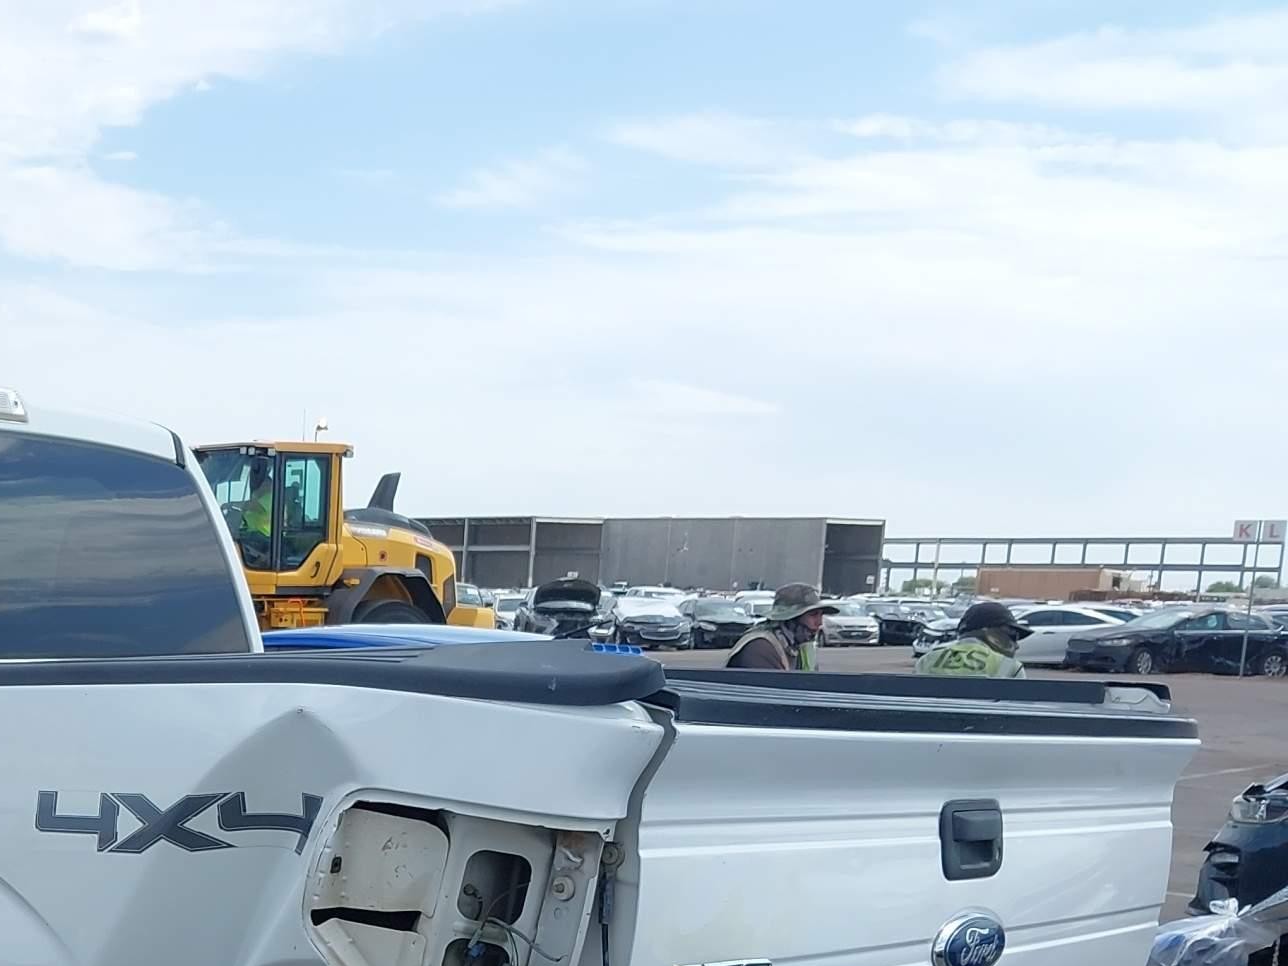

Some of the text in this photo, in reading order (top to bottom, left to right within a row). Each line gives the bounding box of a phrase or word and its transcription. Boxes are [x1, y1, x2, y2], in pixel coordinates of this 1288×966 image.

[1238, 523, 1253, 538] K
[1268, 523, 1281, 538] L
[960, 927, 1000, 966] Ford
